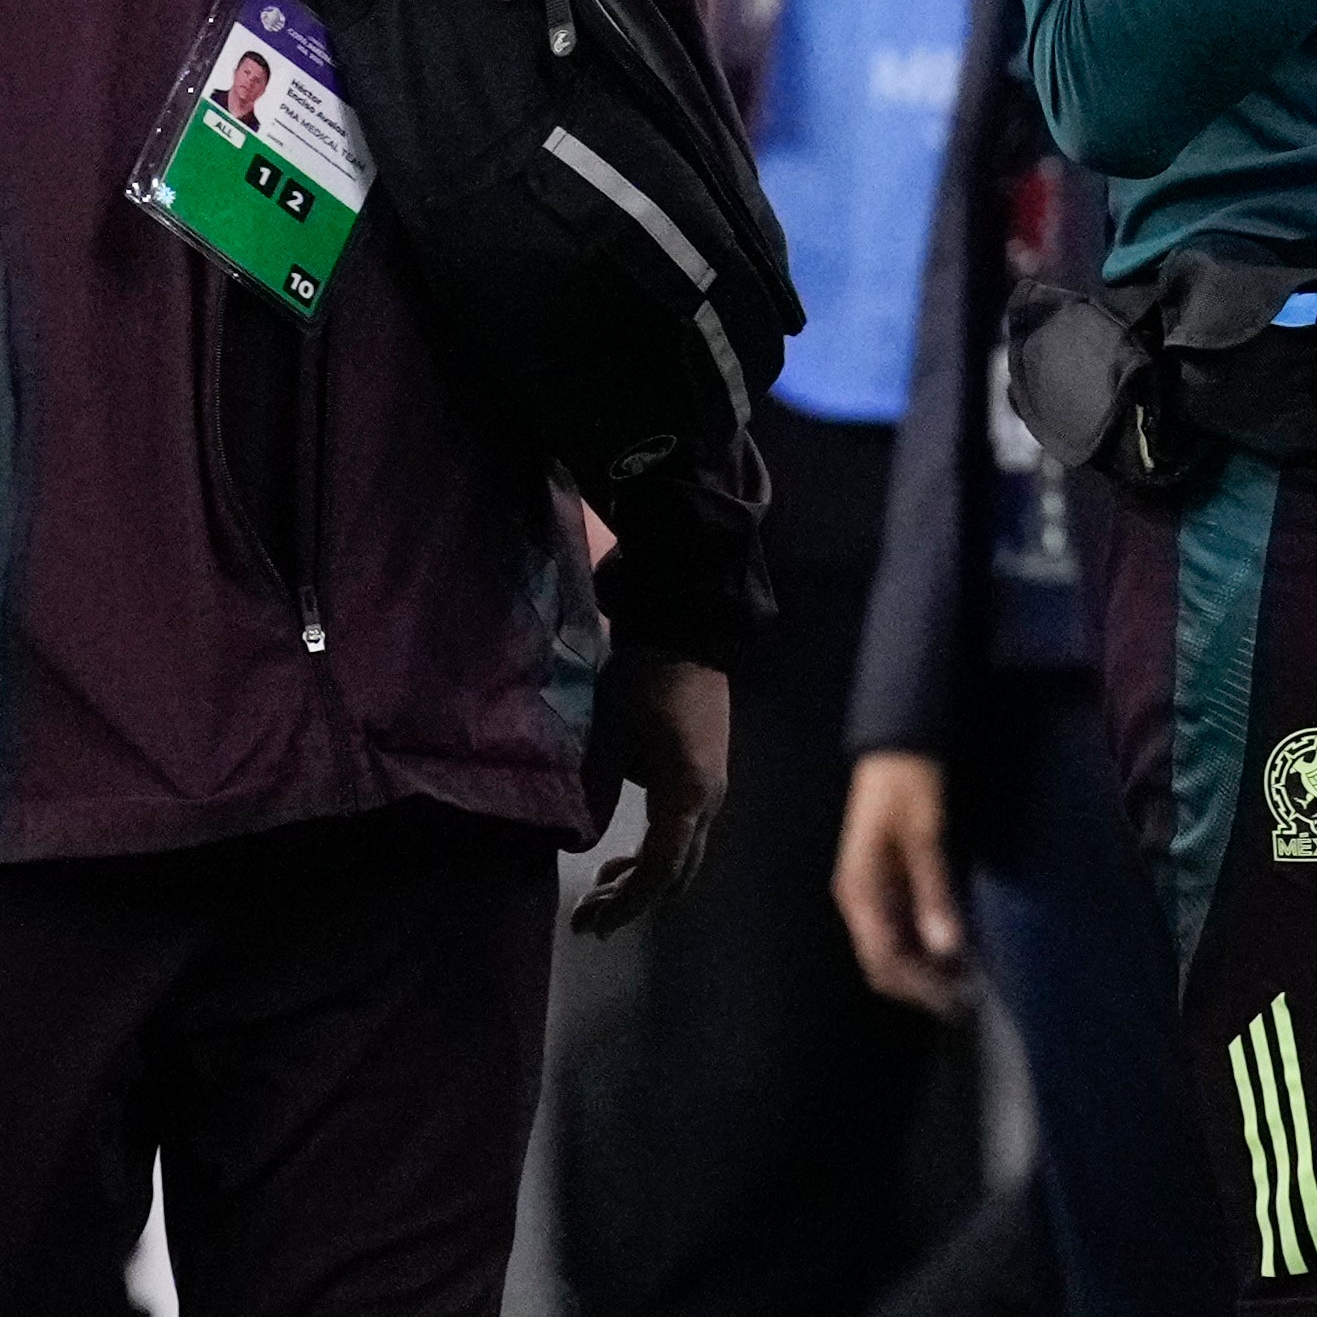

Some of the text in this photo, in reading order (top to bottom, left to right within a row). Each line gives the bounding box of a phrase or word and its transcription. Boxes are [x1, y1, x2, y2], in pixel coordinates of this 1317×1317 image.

[214, 119, 233, 138] ALL
[300, 116, 339, 153] MEDICAL
[258, 166, 304, 212] 1 2
[290, 272, 315, 299] 10
